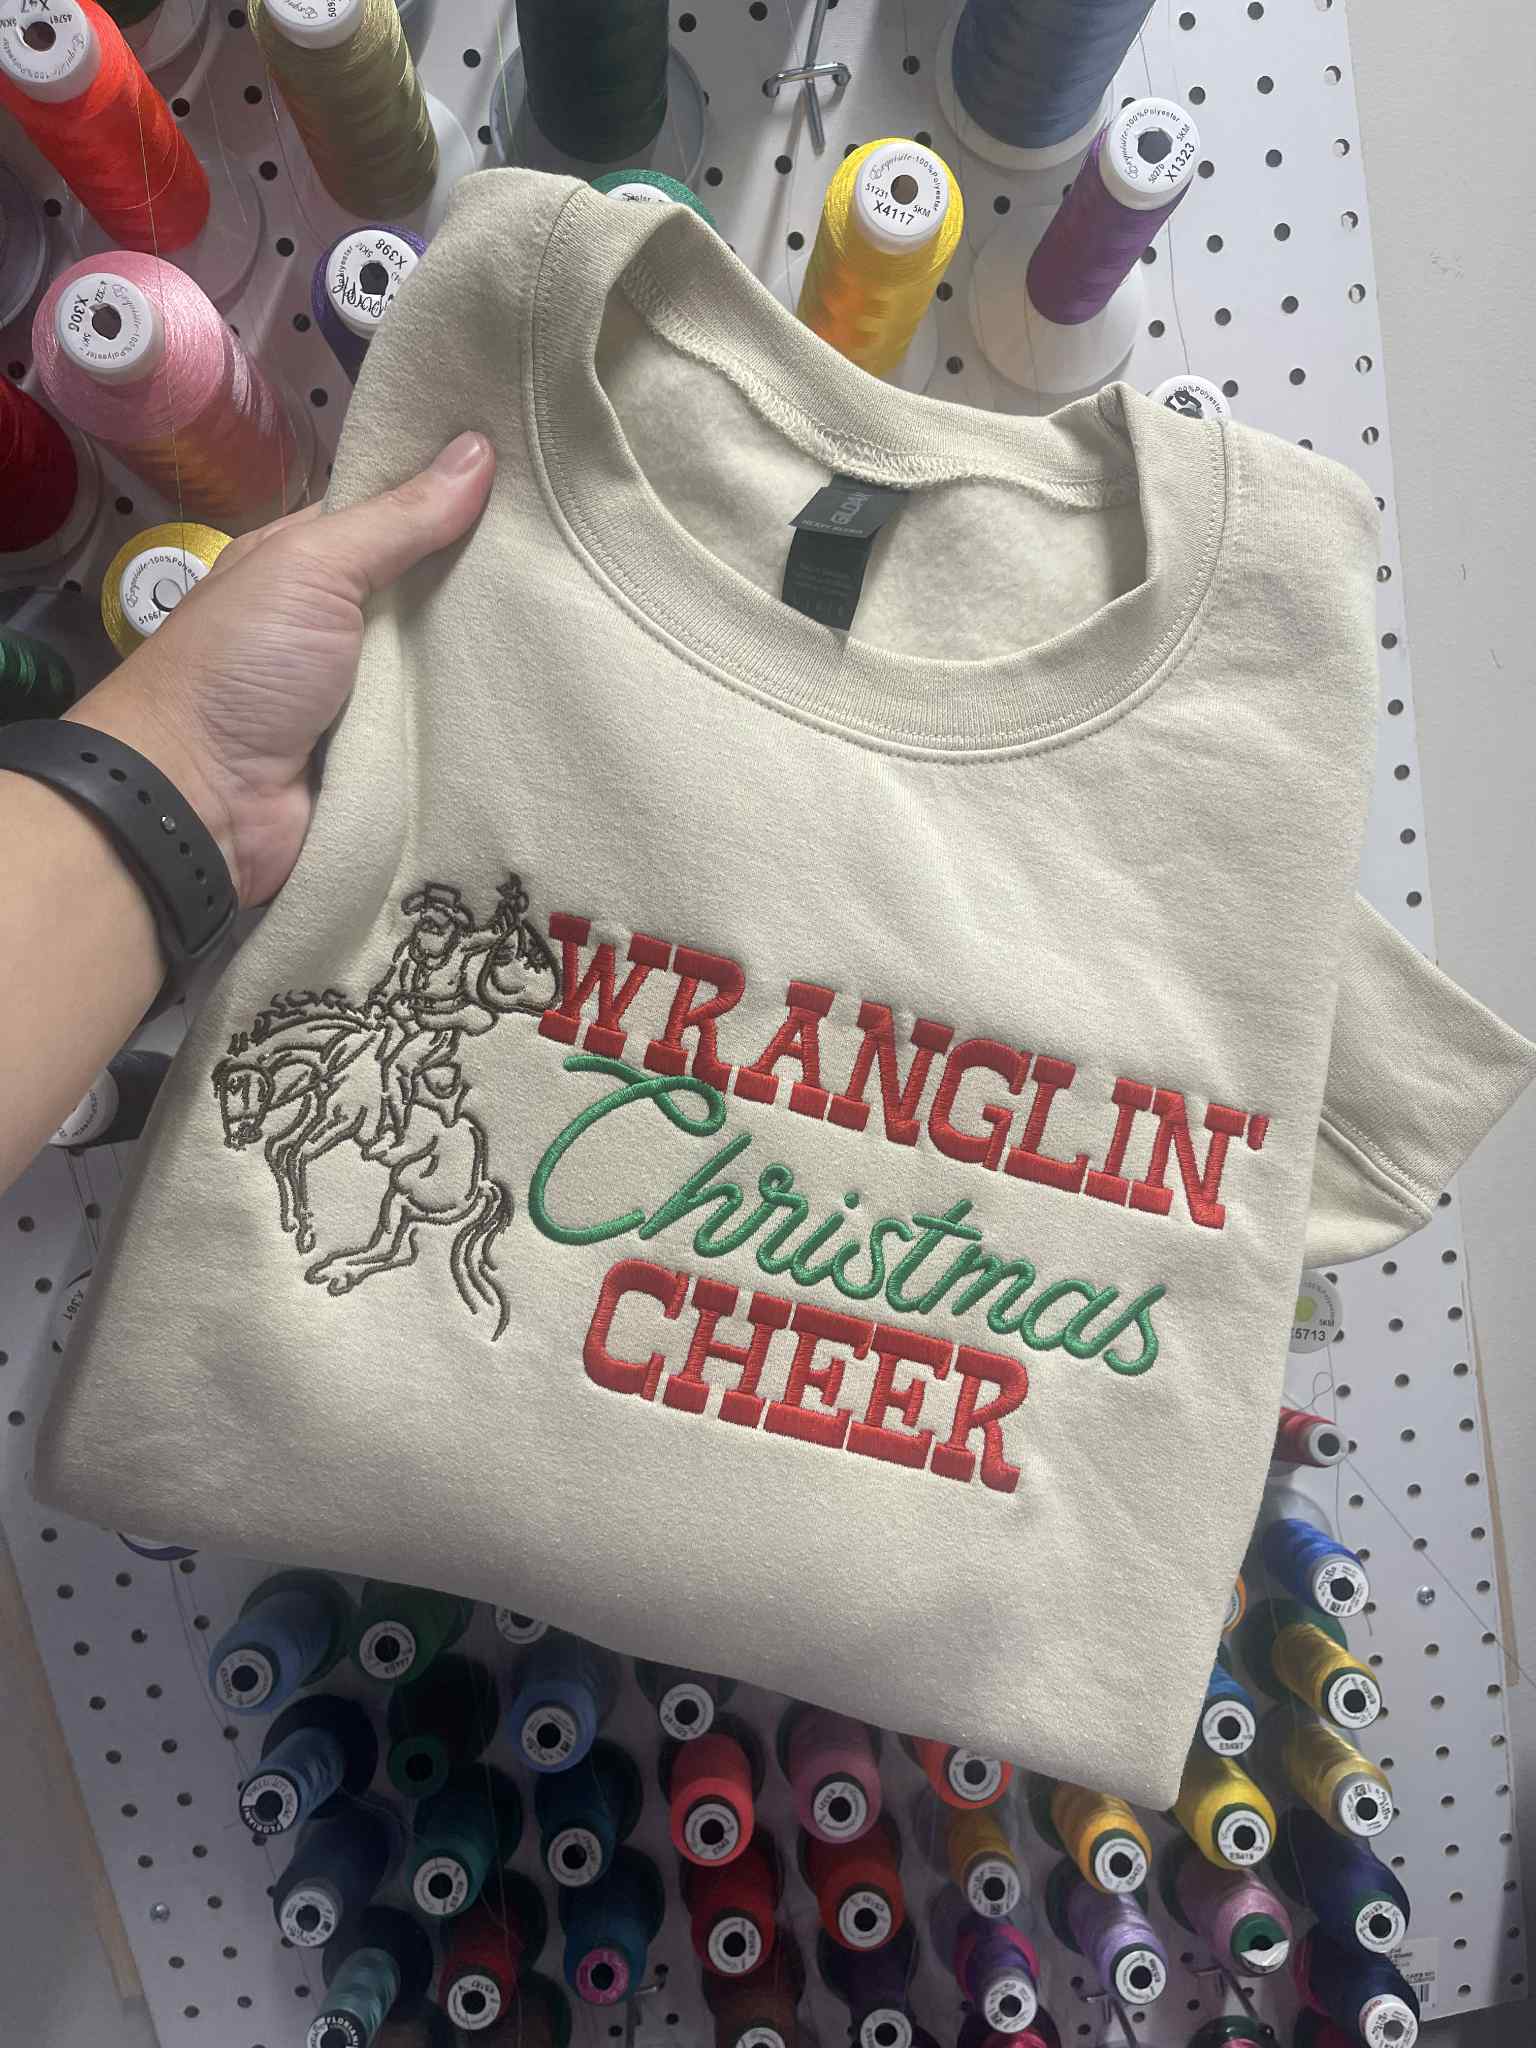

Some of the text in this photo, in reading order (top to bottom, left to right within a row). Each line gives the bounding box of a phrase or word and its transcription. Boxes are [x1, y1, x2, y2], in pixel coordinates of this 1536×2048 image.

[1164, 141, 1195, 183] X1323
[864, 182, 889, 200] 51231
[872, 199, 915, 226] X4117
[912, 204, 932, 218] 5KM
[375, 238, 409, 270] X398
[538, 911, 1270, 1230] WRANGLIN'
[528, 1054, 1167, 1376] Christmas
[582, 1257, 1030, 1494] CHEER
